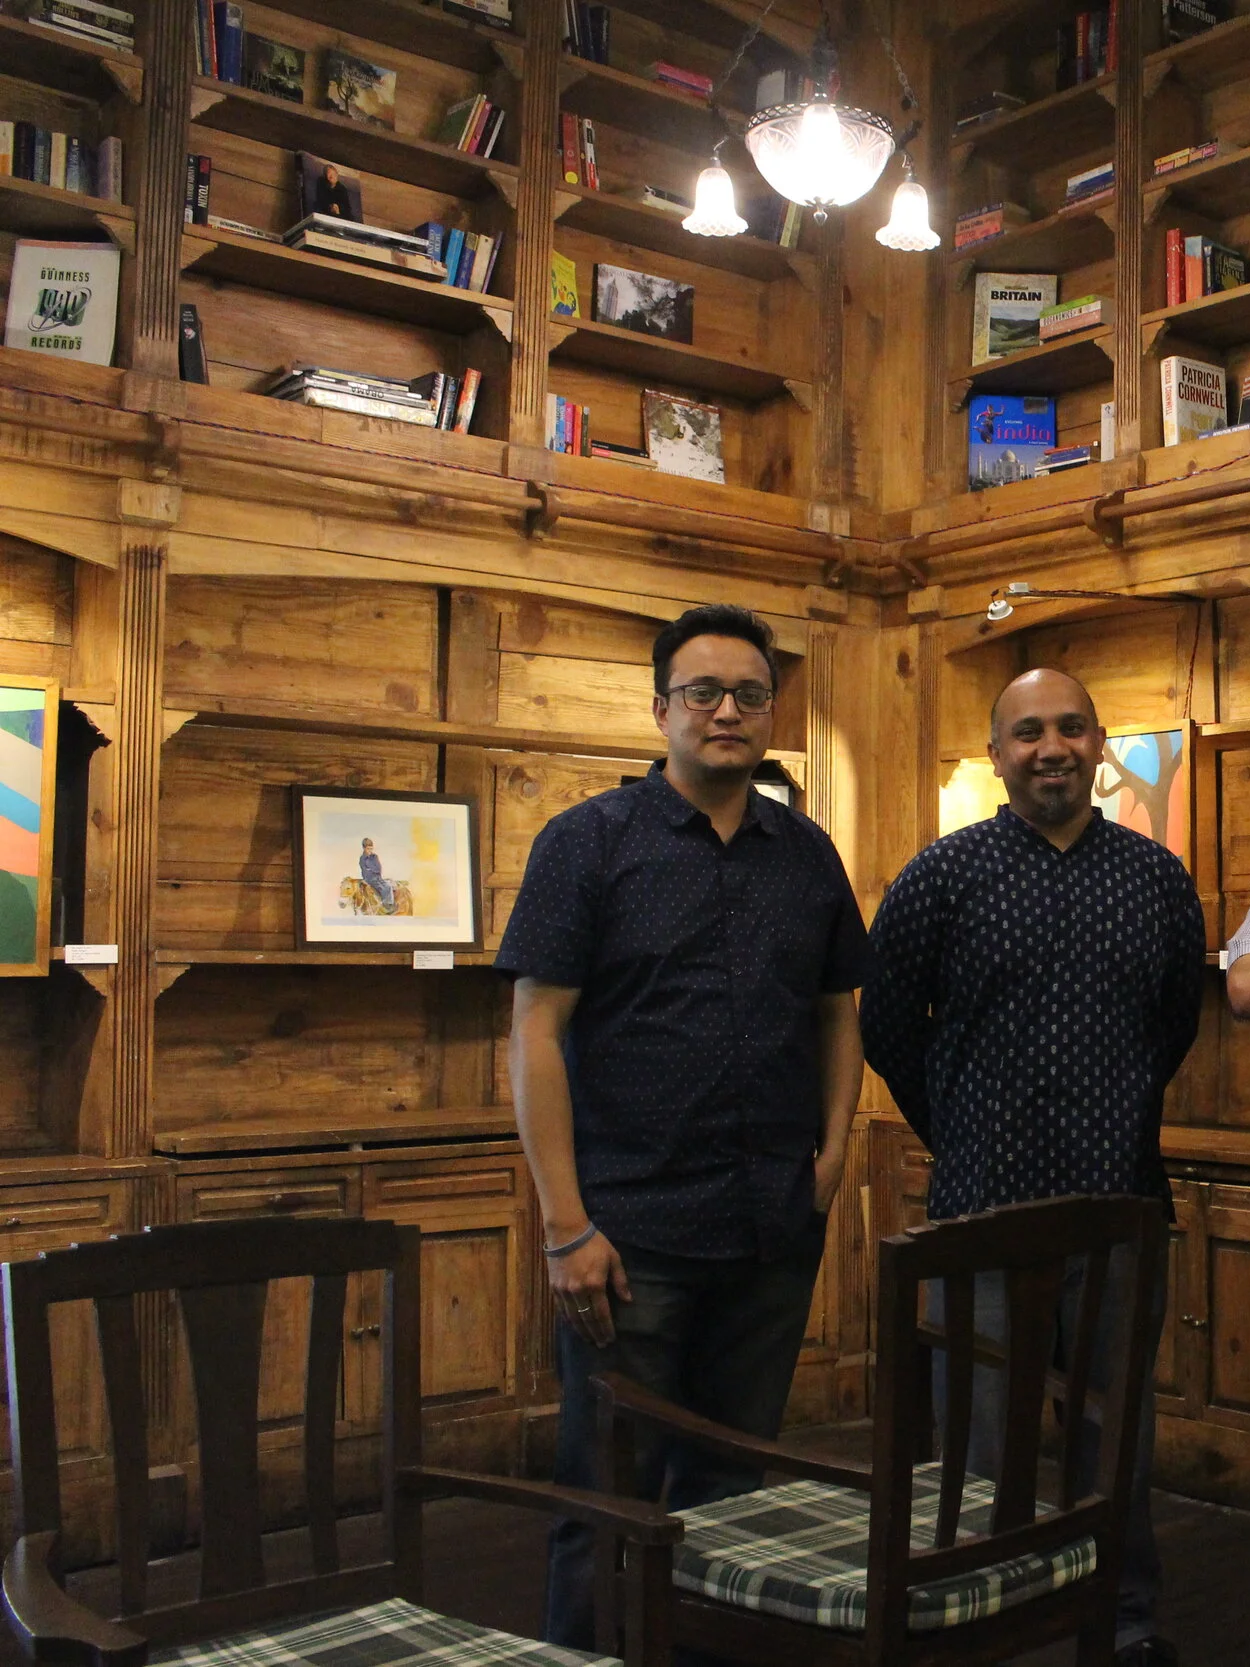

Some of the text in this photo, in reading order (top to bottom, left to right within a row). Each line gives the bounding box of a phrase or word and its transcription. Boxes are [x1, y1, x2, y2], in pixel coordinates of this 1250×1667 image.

[1173, 0, 1216, 25] Patterson
[197, 184, 209, 209] TOXIN
[40, 269, 91, 283] GUINNESS
[990, 290, 1042, 301] BRITAIN
[31, 336, 83, 350] RECORDS
[1181, 365, 1221, 391] PATRICIA
[1178, 382, 1225, 410] CORNWELL
[996, 423, 1051, 440] india
